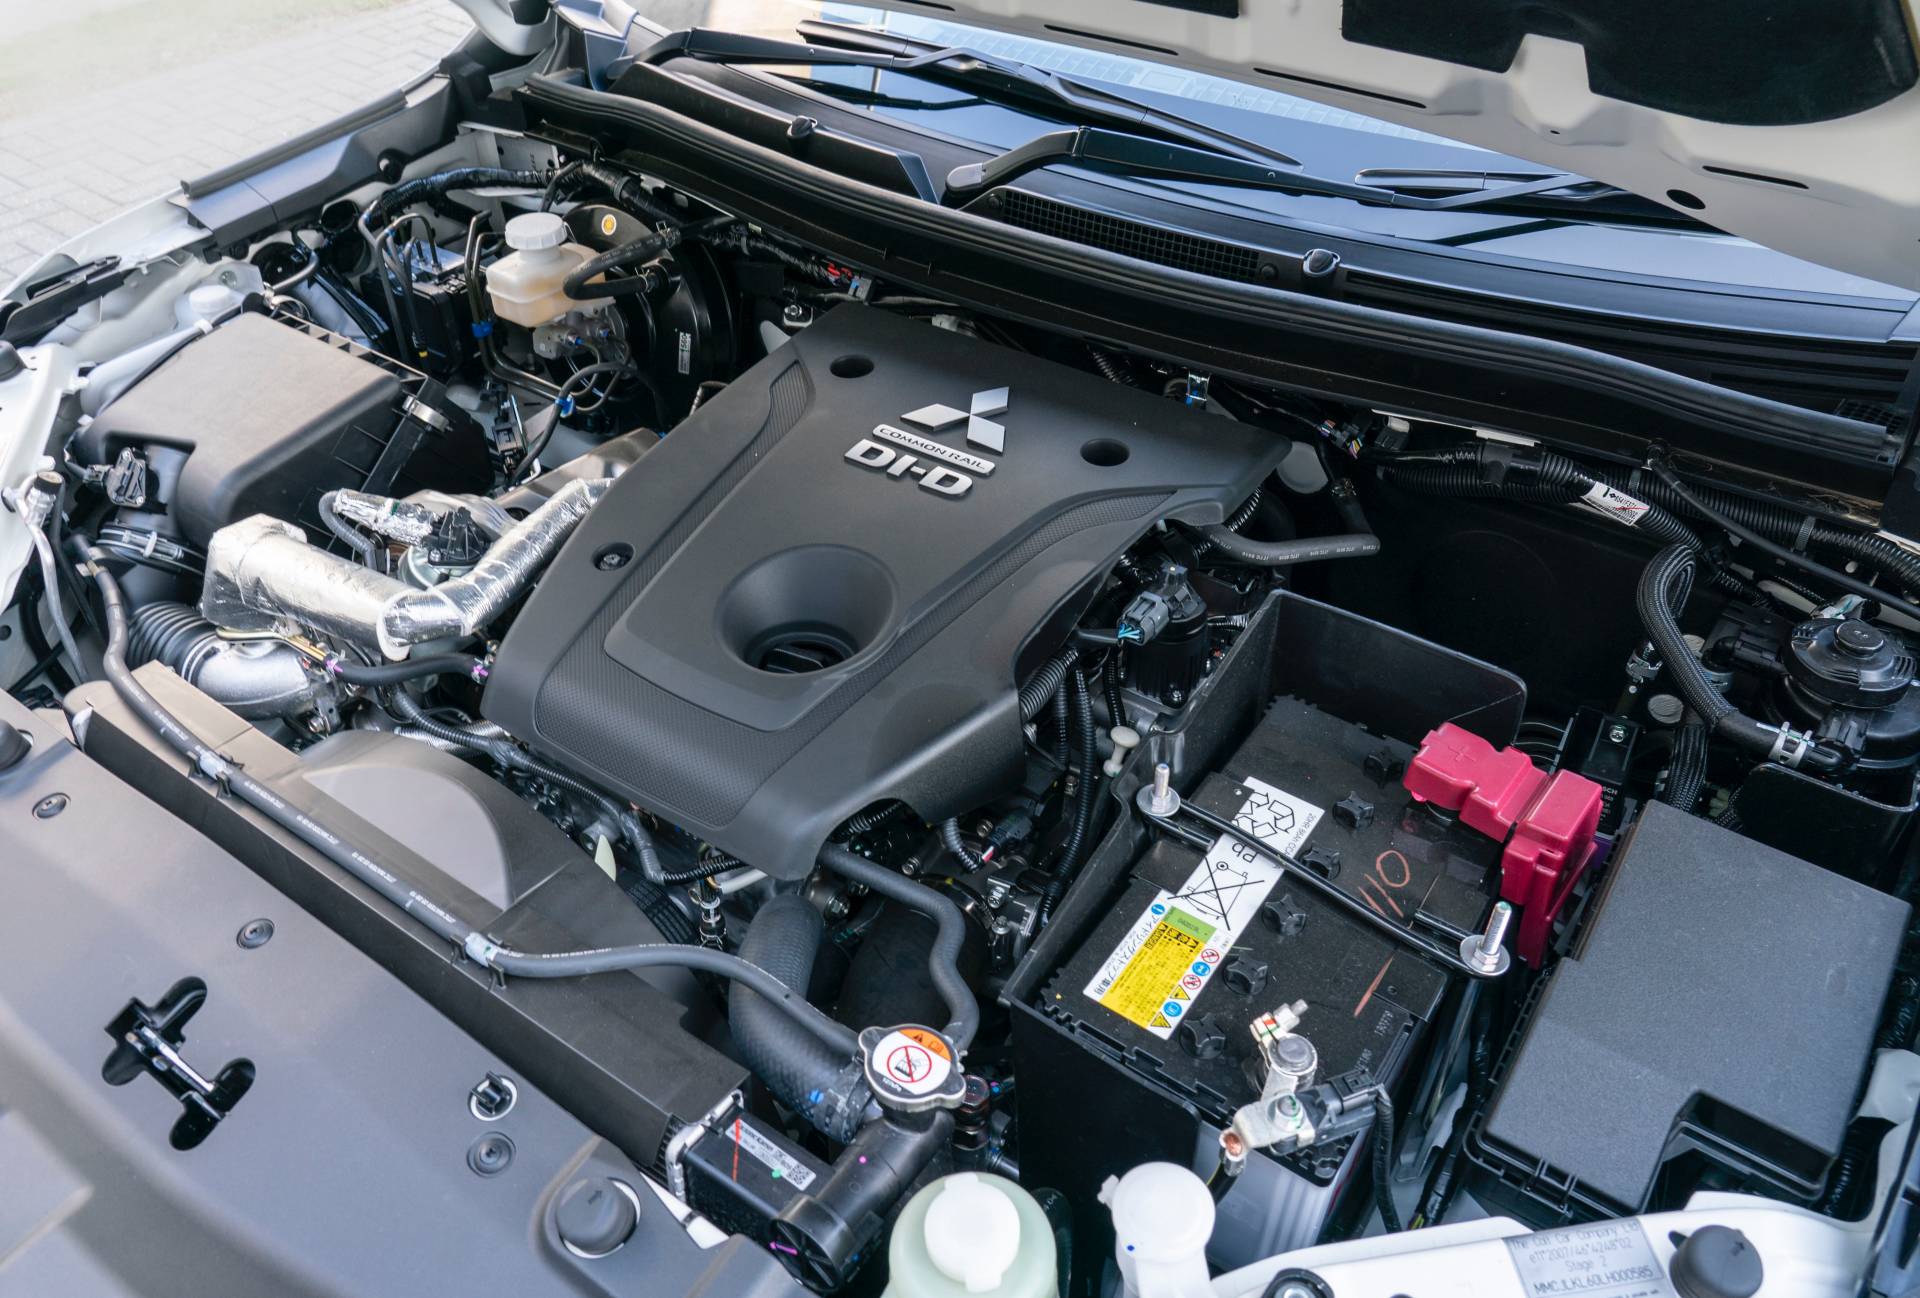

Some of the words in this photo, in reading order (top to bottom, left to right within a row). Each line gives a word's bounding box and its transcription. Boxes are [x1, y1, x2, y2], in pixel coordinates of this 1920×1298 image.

[879, 427, 948, 456] COMMON
[947, 452, 986, 470] RAIL
[844, 438, 973, 496] DI-D
[1231, 842, 1259, 863] Pb
[1555, 1233, 1570, 1242] Car
[1575, 1227, 1618, 1241] Company
[1565, 1257, 1594, 1273] Stage
[1600, 1255, 1608, 1267] 2
